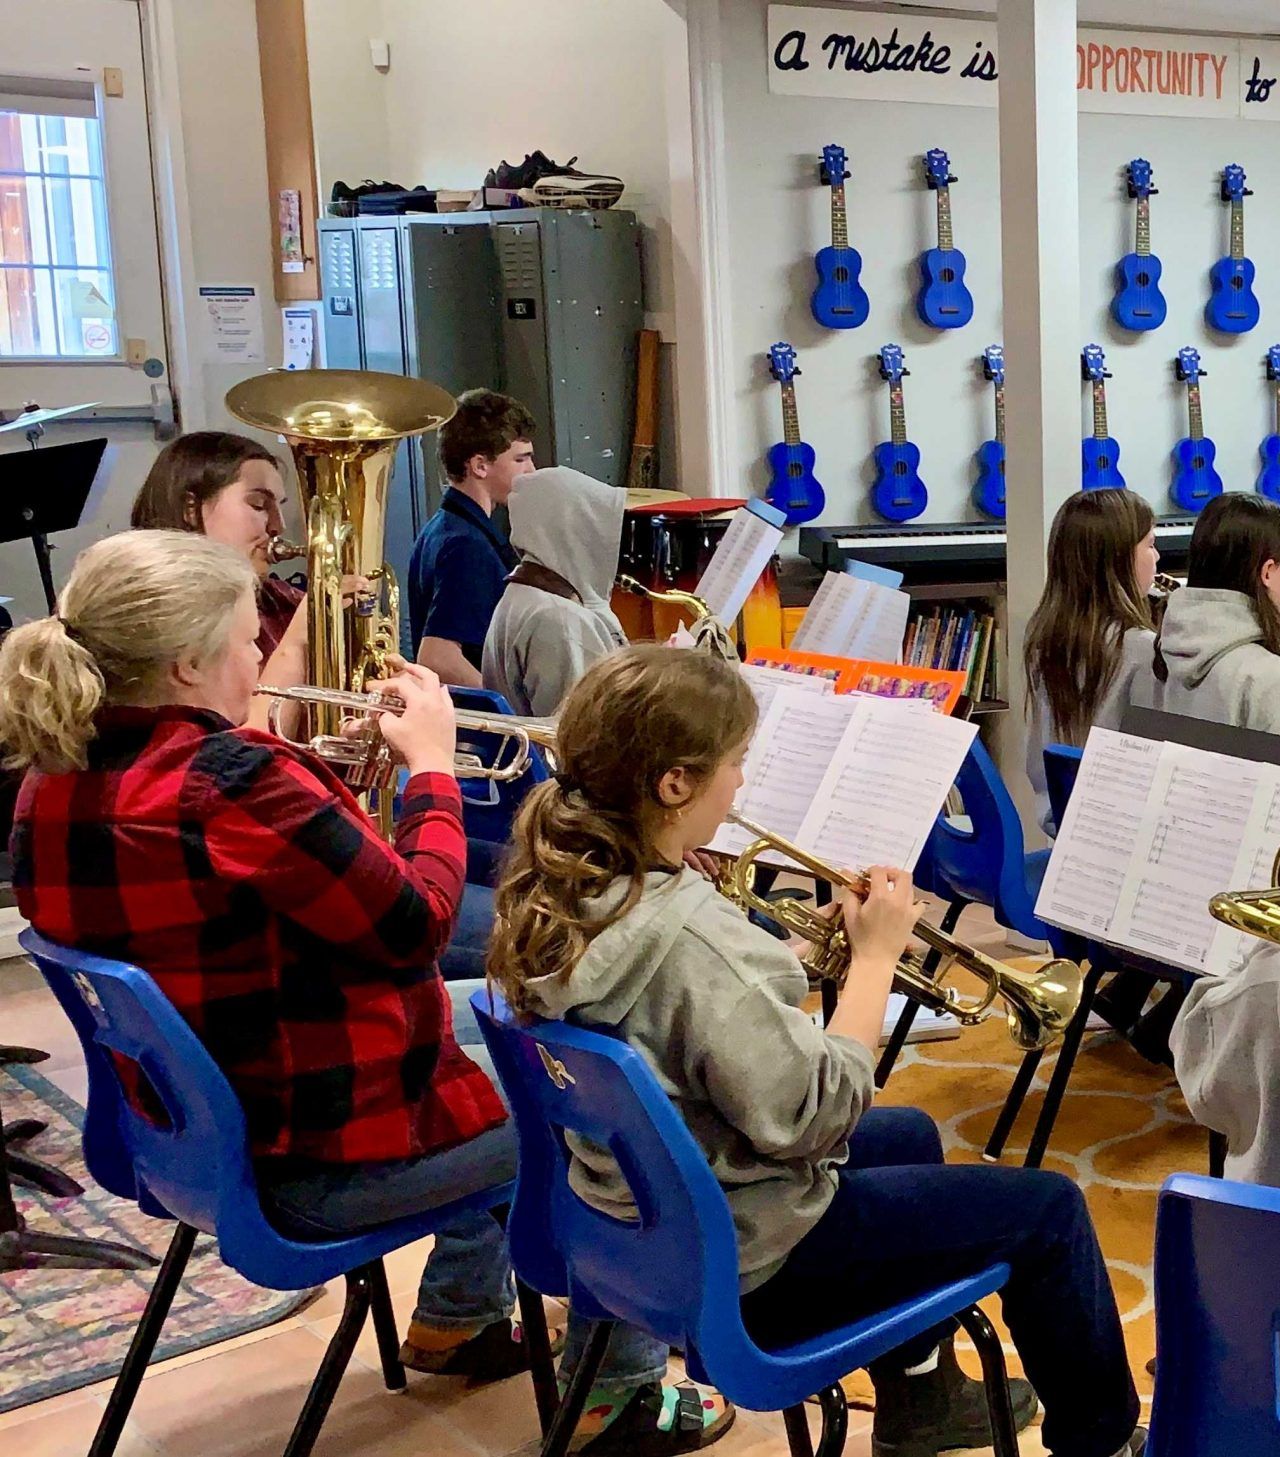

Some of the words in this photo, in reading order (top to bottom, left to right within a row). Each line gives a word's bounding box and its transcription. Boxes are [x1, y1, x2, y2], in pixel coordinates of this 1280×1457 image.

[822, 28, 951, 74] mistake
[960, 41, 999, 81] is
[1245, 56, 1277, 103] to
